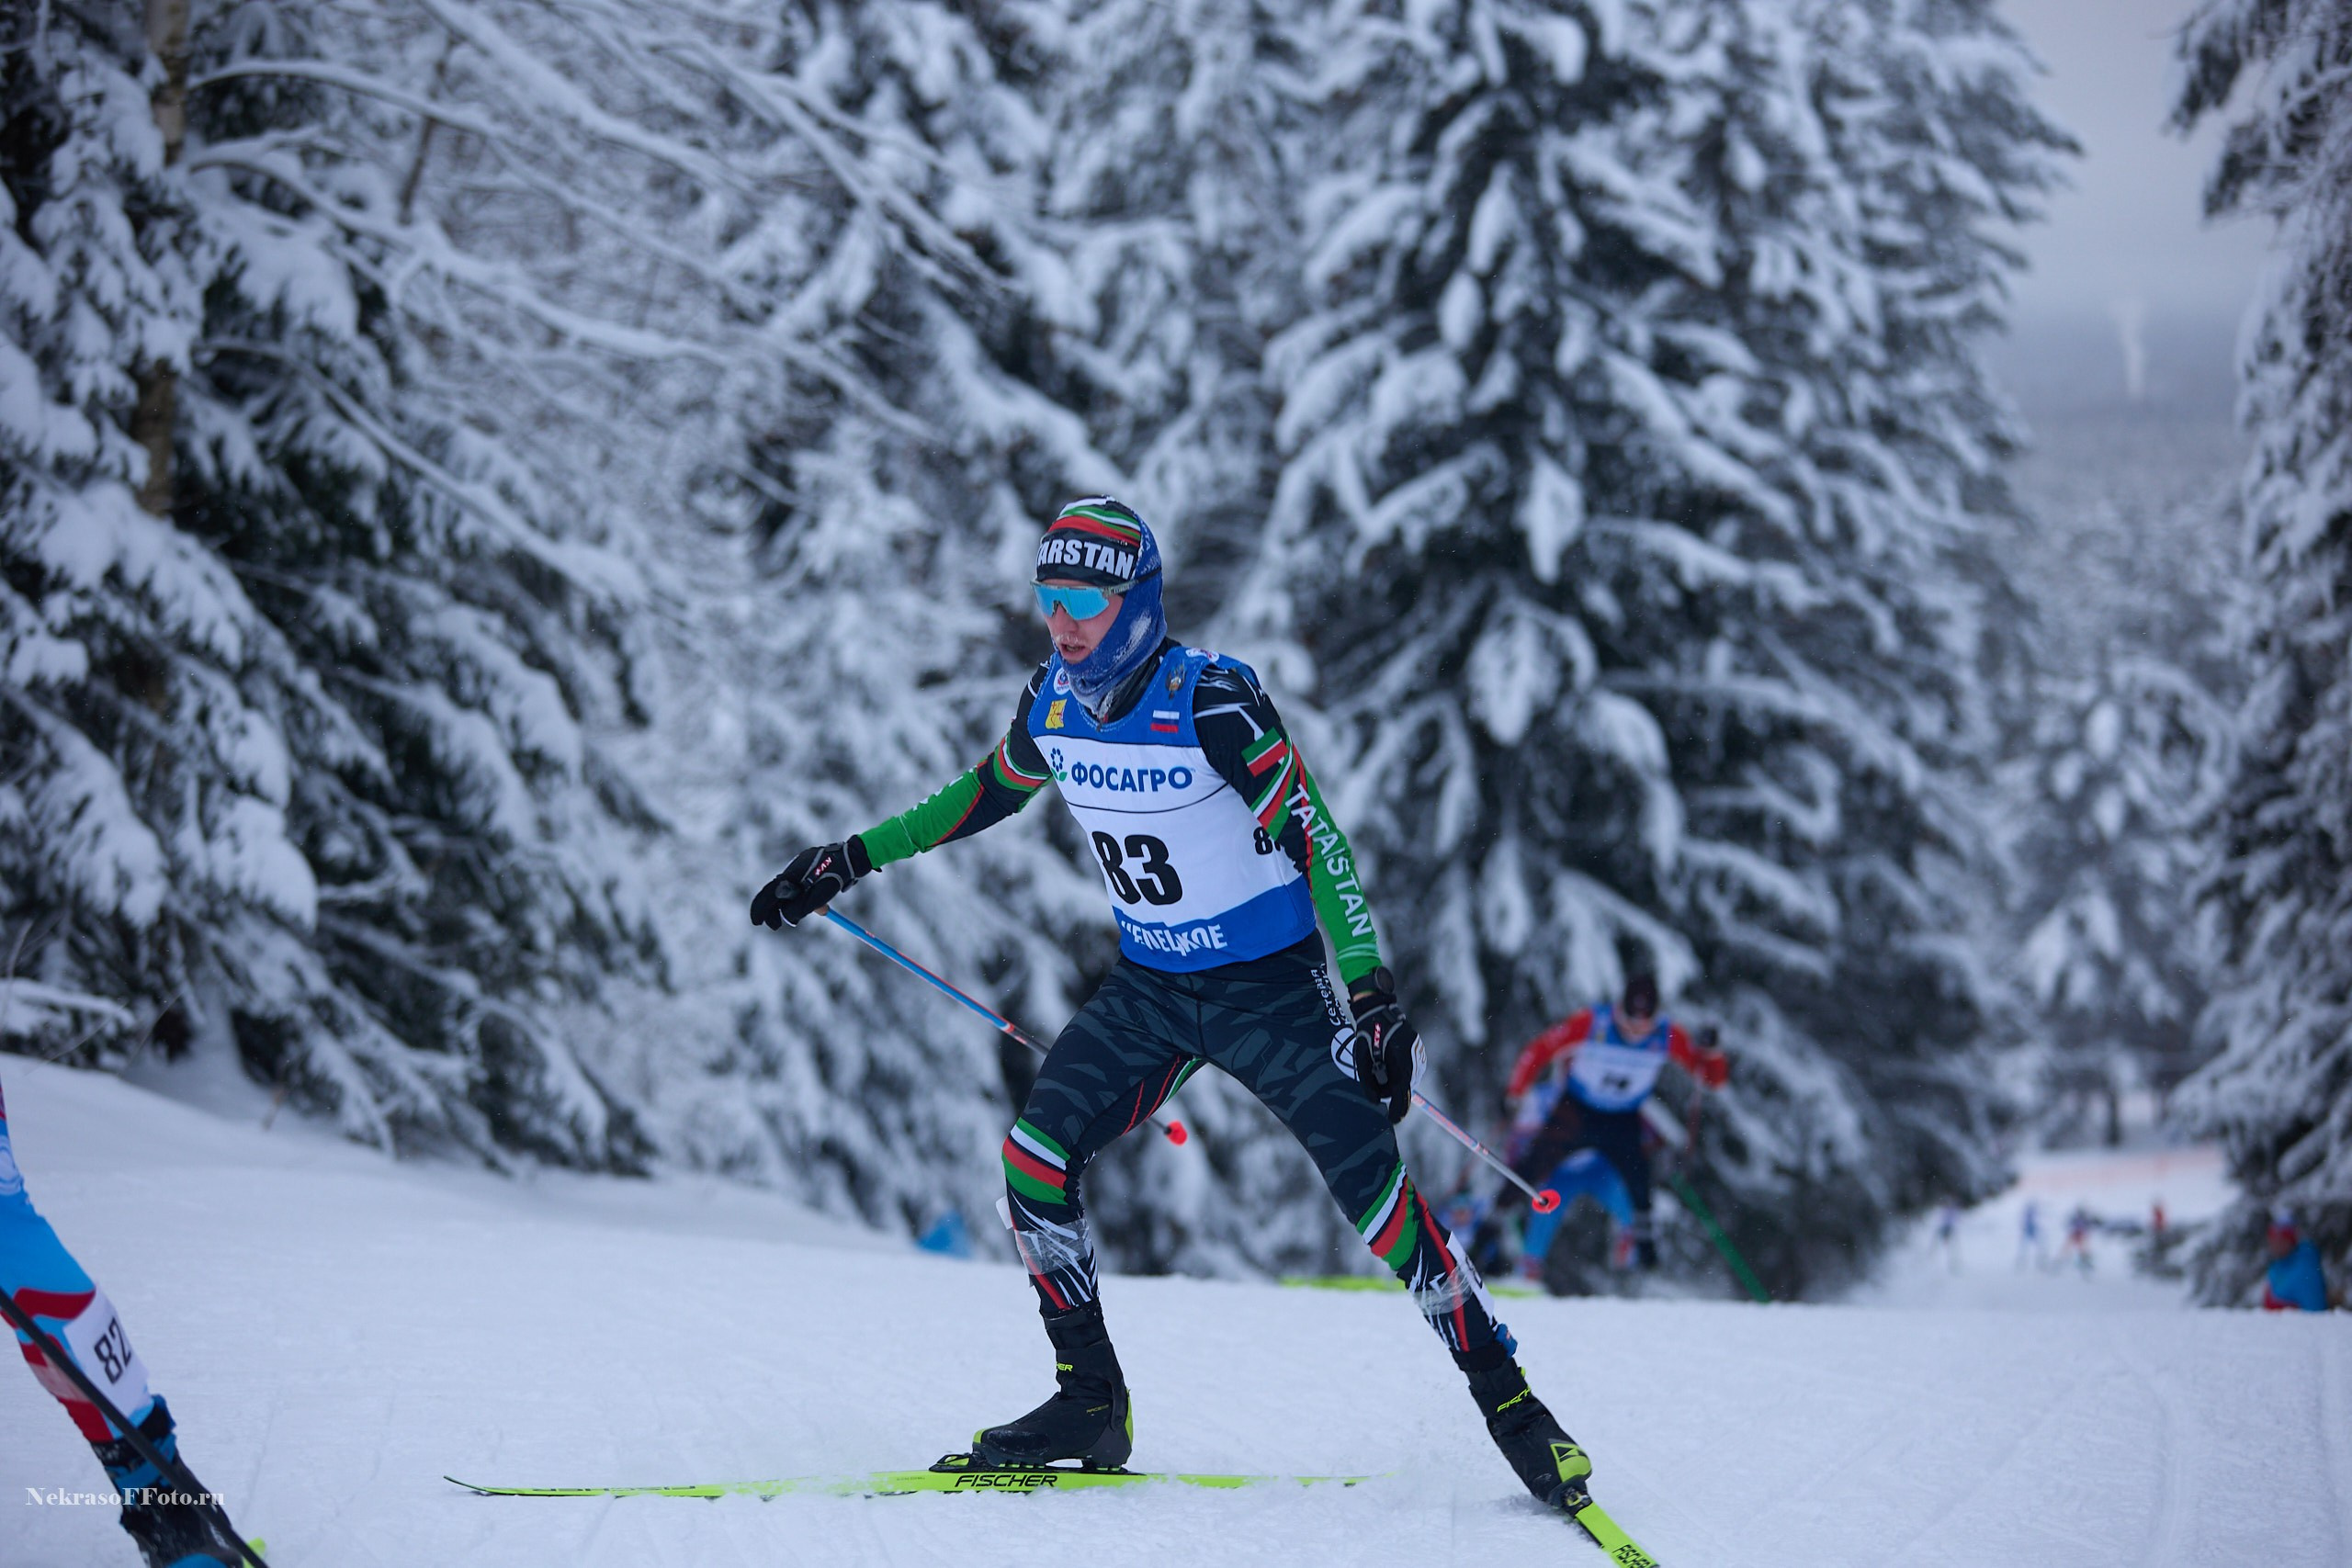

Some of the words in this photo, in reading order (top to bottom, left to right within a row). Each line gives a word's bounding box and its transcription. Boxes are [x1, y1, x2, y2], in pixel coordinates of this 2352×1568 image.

[1036, 539, 1134, 581] ARSTAN
[1071, 761, 1193, 792] ФОСАГРО
[1252, 827, 1281, 855] 8
[1091, 830, 1183, 906] 83
[94, 1316, 132, 1385] 82
[955, 1474, 1057, 1488] FISCHER
